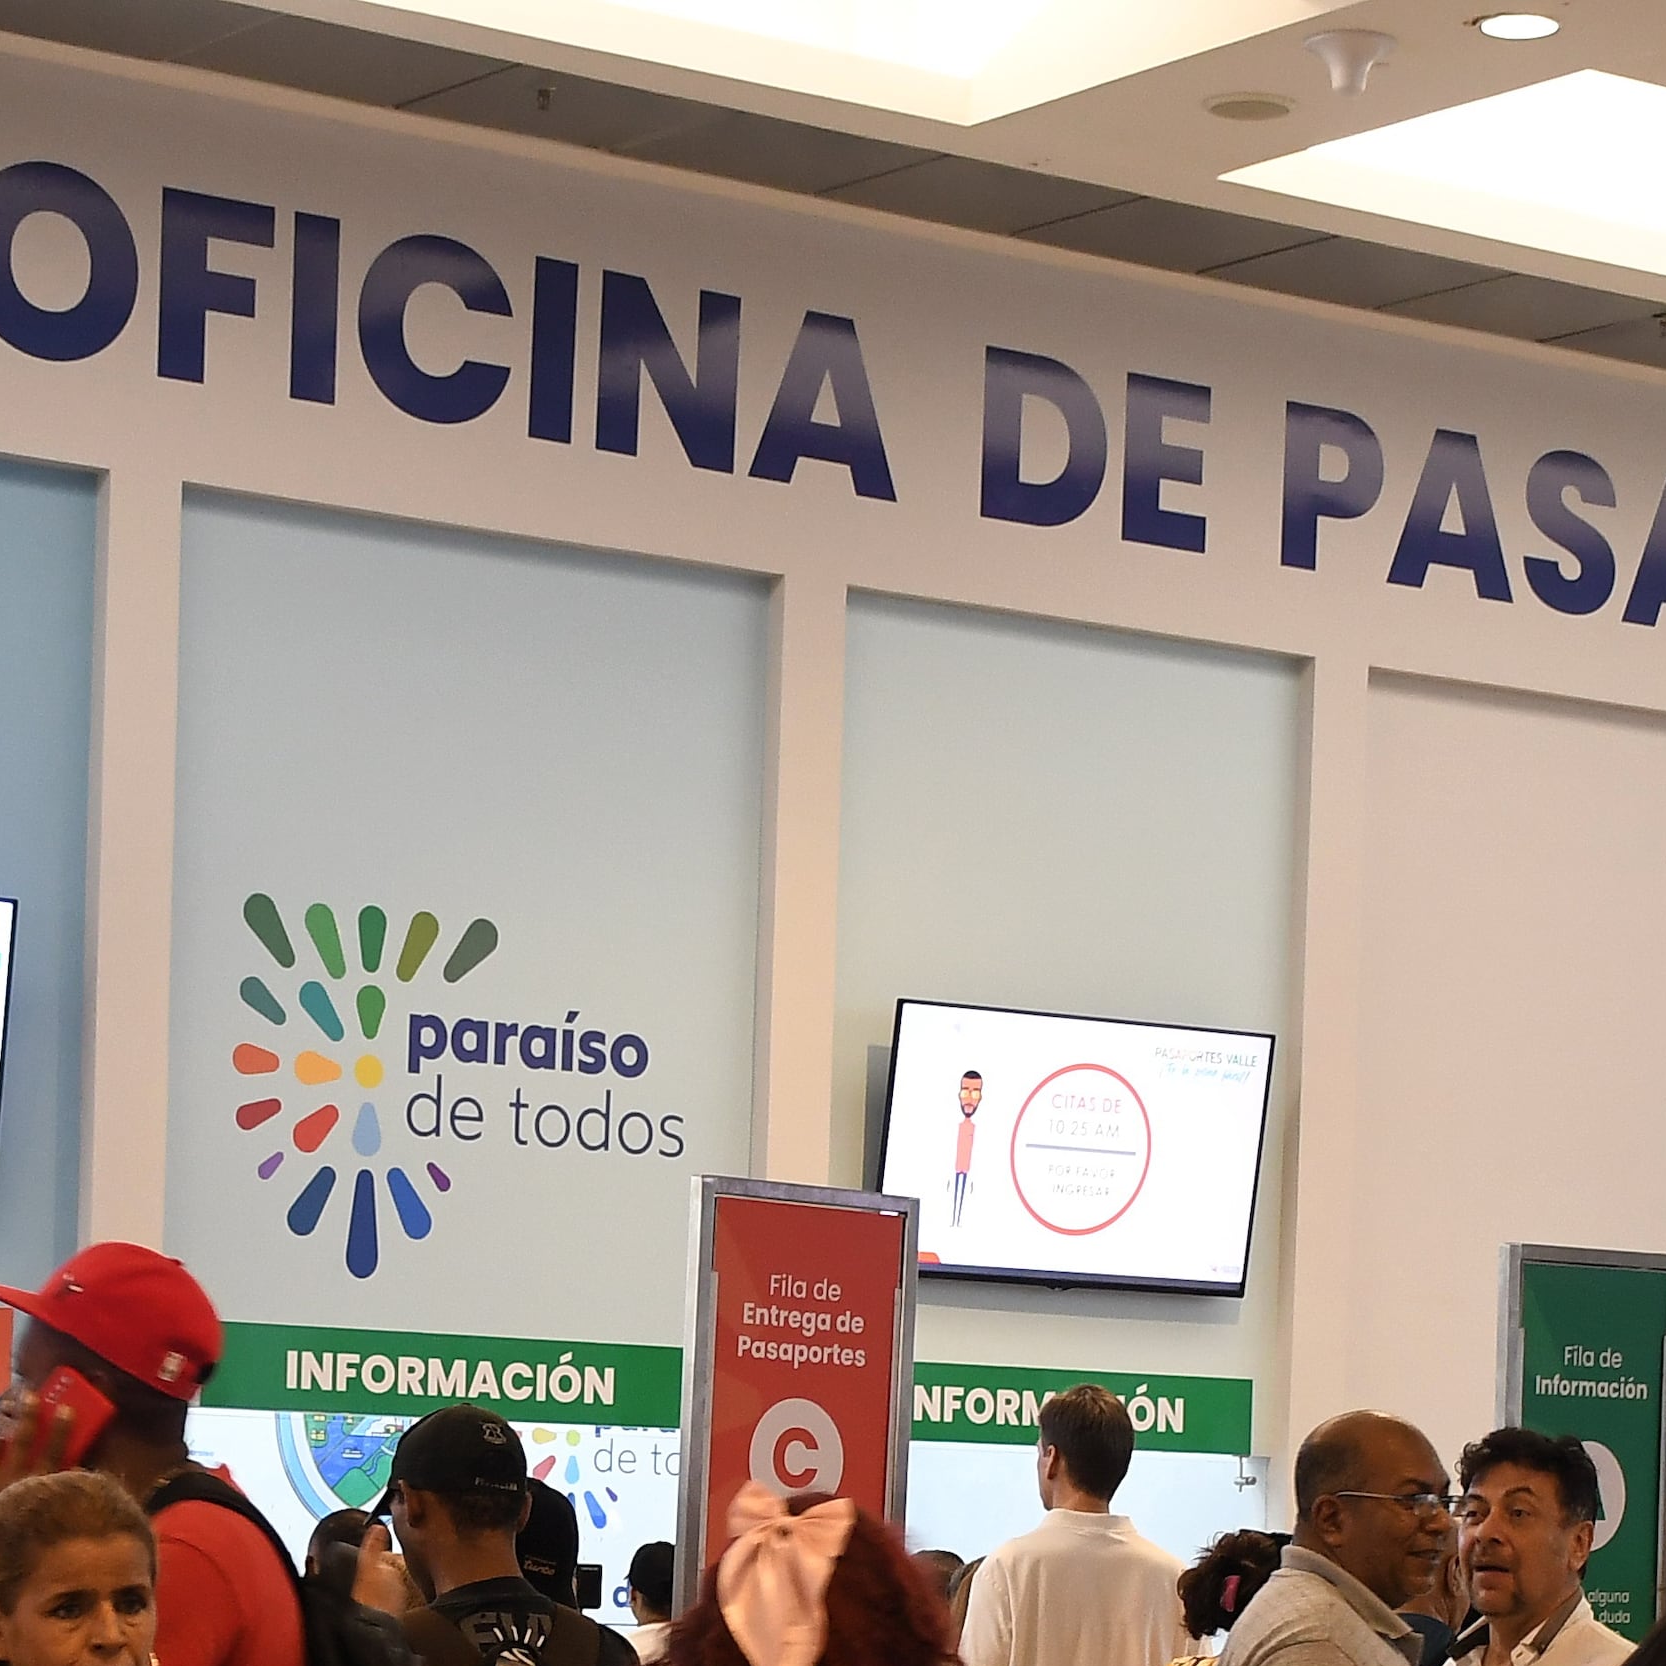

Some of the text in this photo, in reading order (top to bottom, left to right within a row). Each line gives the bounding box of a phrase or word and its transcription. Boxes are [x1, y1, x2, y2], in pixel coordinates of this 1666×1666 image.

[979, 343, 1213, 555] DE
[406, 1010, 649, 1077] paraíso
[1226, 1053, 1259, 1068] VALLE
[405, 1074, 686, 1159] de todos
[1051, 1094, 1123, 1114] CITAS DE
[1095, 1123, 1120, 1138] AM
[768, 1272, 843, 1302] Fila de
[742, 1302, 865, 1338] Entrega de
[736, 1335, 867, 1370] Pasaportes
[1563, 1344, 1623, 1369] Fila de
[285, 1349, 616, 1406] INFORMACIÓN
[1535, 1373, 1649, 1401] Información
[593, 1437, 637, 1474] de
[772, 1426, 821, 1489] C
[1587, 1588, 1631, 1607] alguna
[1598, 1603, 1631, 1624] duda
